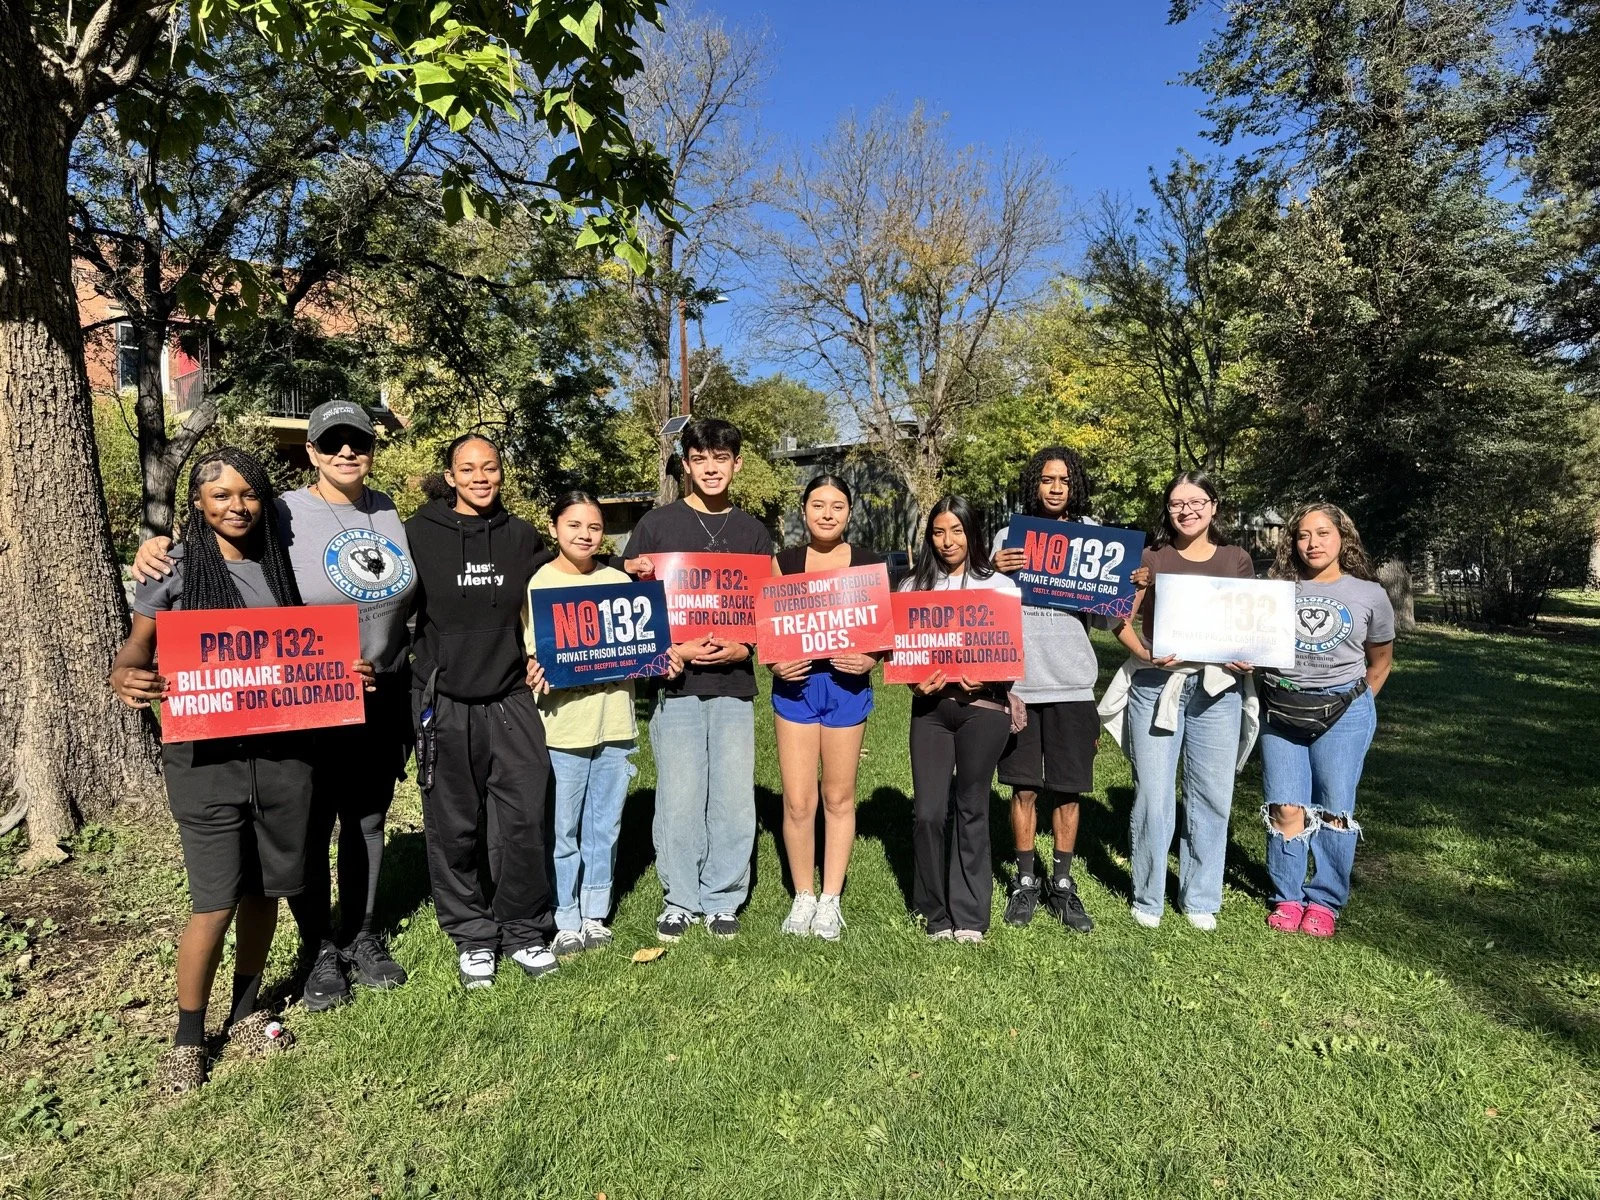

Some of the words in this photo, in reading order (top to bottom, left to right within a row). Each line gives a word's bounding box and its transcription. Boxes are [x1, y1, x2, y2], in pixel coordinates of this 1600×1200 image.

[331, 531, 387, 552] COLORADO
[1023, 530, 1069, 575] NO
[1068, 537, 1126, 583] 132
[328, 564, 364, 598] CIRCLES
[366, 589, 388, 599] FOR
[456, 574, 504, 587] Mercy
[713, 568, 749, 590] 132:
[762, 581, 808, 599] PRISONS
[808, 577, 840, 594] DON'T
[841, 572, 881, 587] REDUCE
[1018, 572, 1049, 586] PRIVATE
[1049, 576, 1076, 590] PRISON
[1077, 580, 1097, 592] CASH
[1098, 583, 1118, 596] GRAB
[667, 594, 720, 609] LIONAIRE
[773, 594, 828, 613] OVERDOSE
[828, 589, 871, 606] DEATHS.
[1220, 591, 1277, 633] 132
[1295, 596, 1344, 610] OLORADO
[551, 600, 601, 650] NO
[598, 595, 655, 644] 132
[688, 611, 709, 626] FOR
[770, 604, 878, 636] TREATMENT
[908, 606, 955, 629] PROP
[957, 604, 995, 627] 132:
[200, 630, 269, 663] PROP
[272, 627, 324, 658] 132:
[801, 629, 856, 653] DOES.
[895, 632, 964, 649] BILLIONAIRE
[965, 631, 1014, 646] BACKED.
[1299, 641, 1318, 651] FOR
[1321, 622, 1351, 650] CHANGE
[556, 650, 589, 664] PRIVATE
[590, 647, 617, 660] PRISON
[617, 645, 637, 656] CASH
[638, 643, 657, 655] GRAB
[931, 650, 953, 665] FOR
[955, 648, 1021, 664] COLORADO.
[177, 664, 282, 692] BILLIONAIRE
[284, 661, 350, 684] BACKED.
[574, 664, 594, 673] COSTLY.
[594, 661, 620, 671] DECEPTIVE.
[620, 659, 639, 668] DEADLY.
[167, 691, 234, 717] WRONG
[236, 689, 269, 711] FOR
[271, 682, 360, 707] COLORADO.
